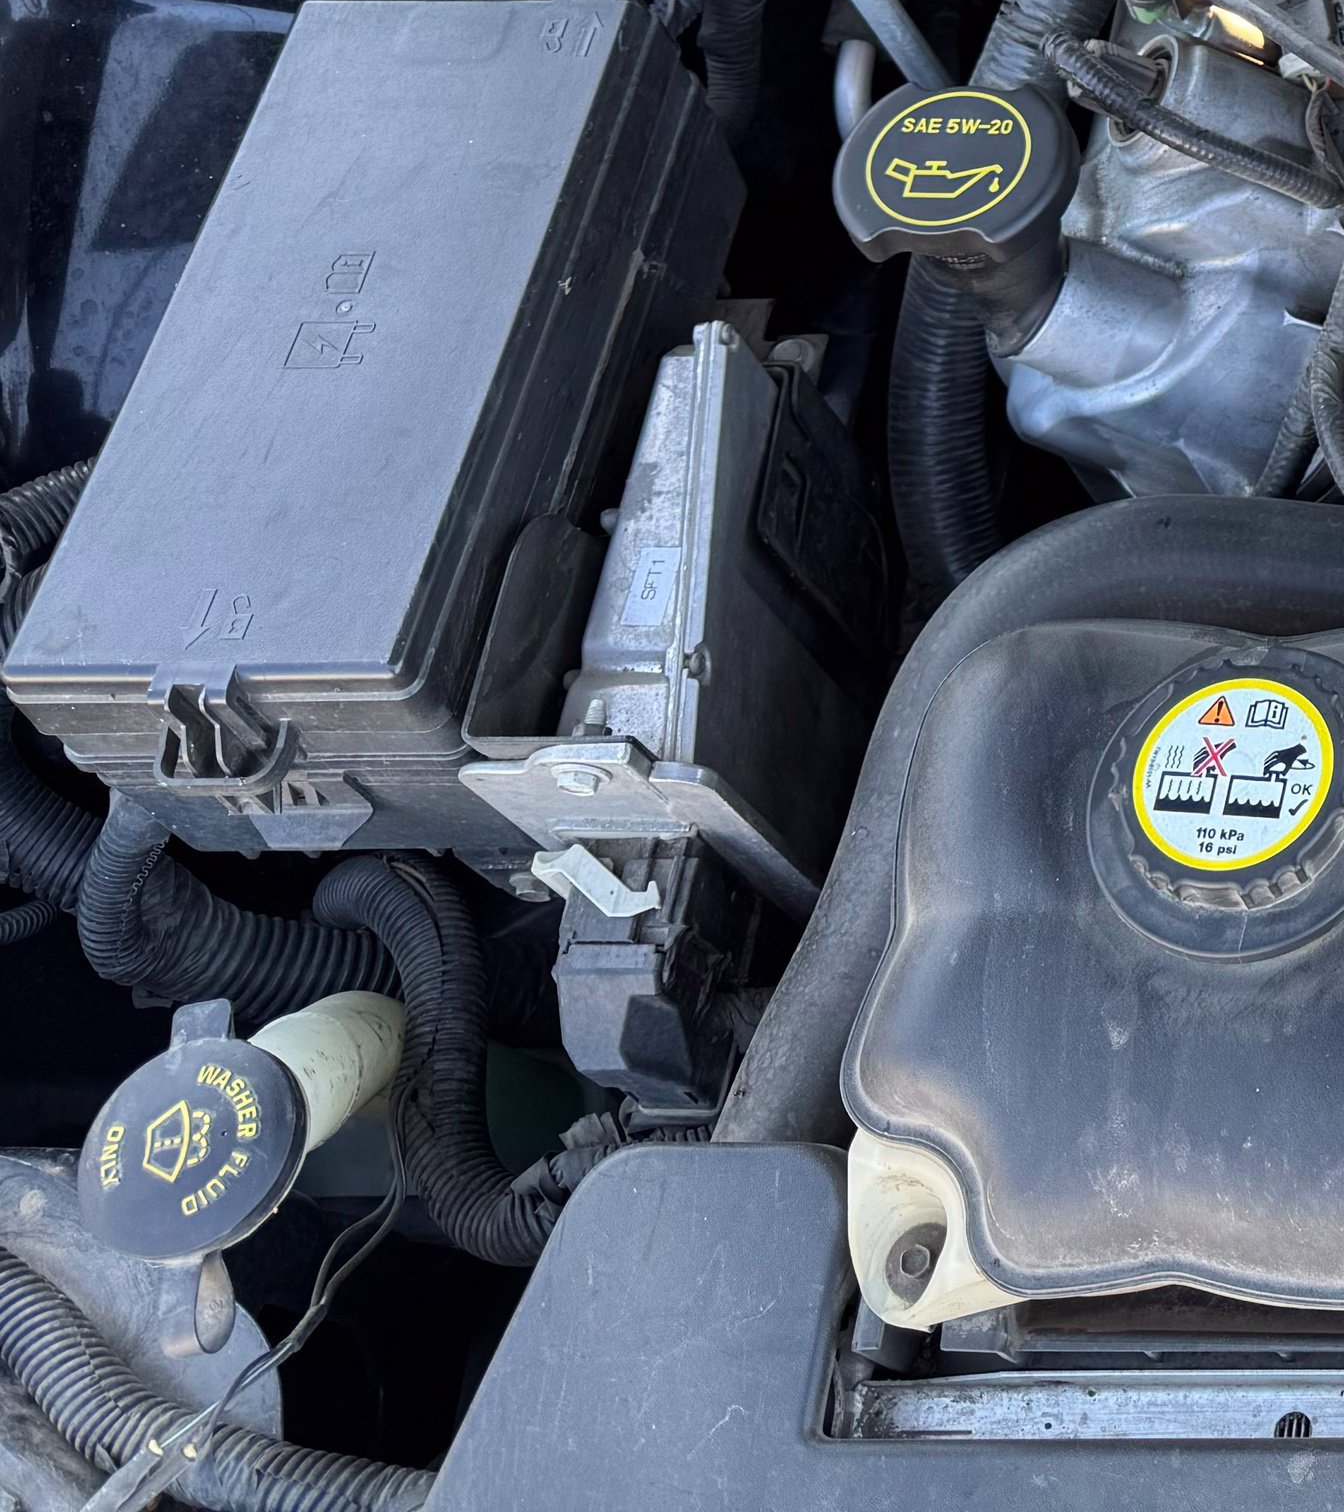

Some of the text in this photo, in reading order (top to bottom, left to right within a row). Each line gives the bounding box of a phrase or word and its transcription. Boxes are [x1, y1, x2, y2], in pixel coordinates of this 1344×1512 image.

[901, 117, 1014, 135] SAE 5W-20
[1290, 783, 1313, 796] OK
[1196, 826, 1245, 842] 110 kPa
[1198, 841, 1238, 856] 16 psi
[181, 1064, 259, 1216] WASHER FLUID
[100, 1125, 126, 1187] ONLY
